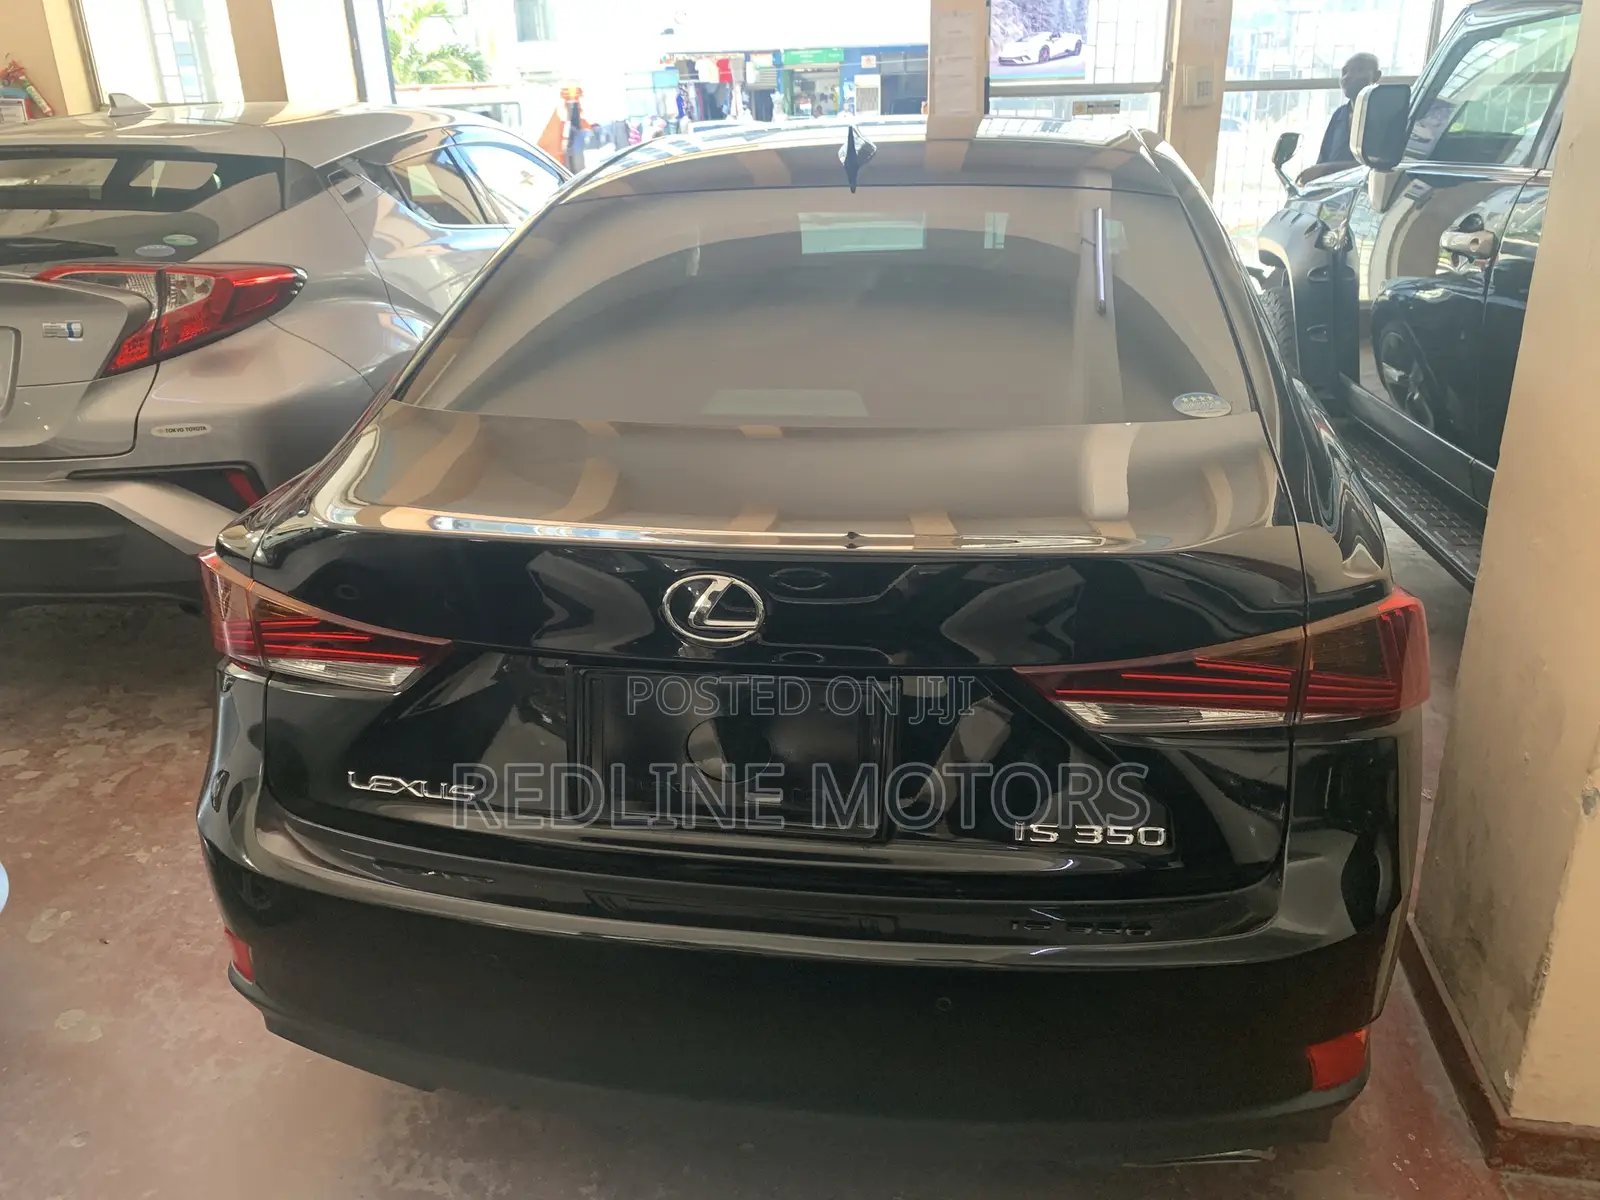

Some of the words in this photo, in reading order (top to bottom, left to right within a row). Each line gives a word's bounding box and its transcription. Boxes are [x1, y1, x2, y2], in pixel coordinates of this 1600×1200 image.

[347, 771, 476, 802] LEXUS
[1014, 821, 1060, 844] IS
[1074, 824, 1167, 847] 350
